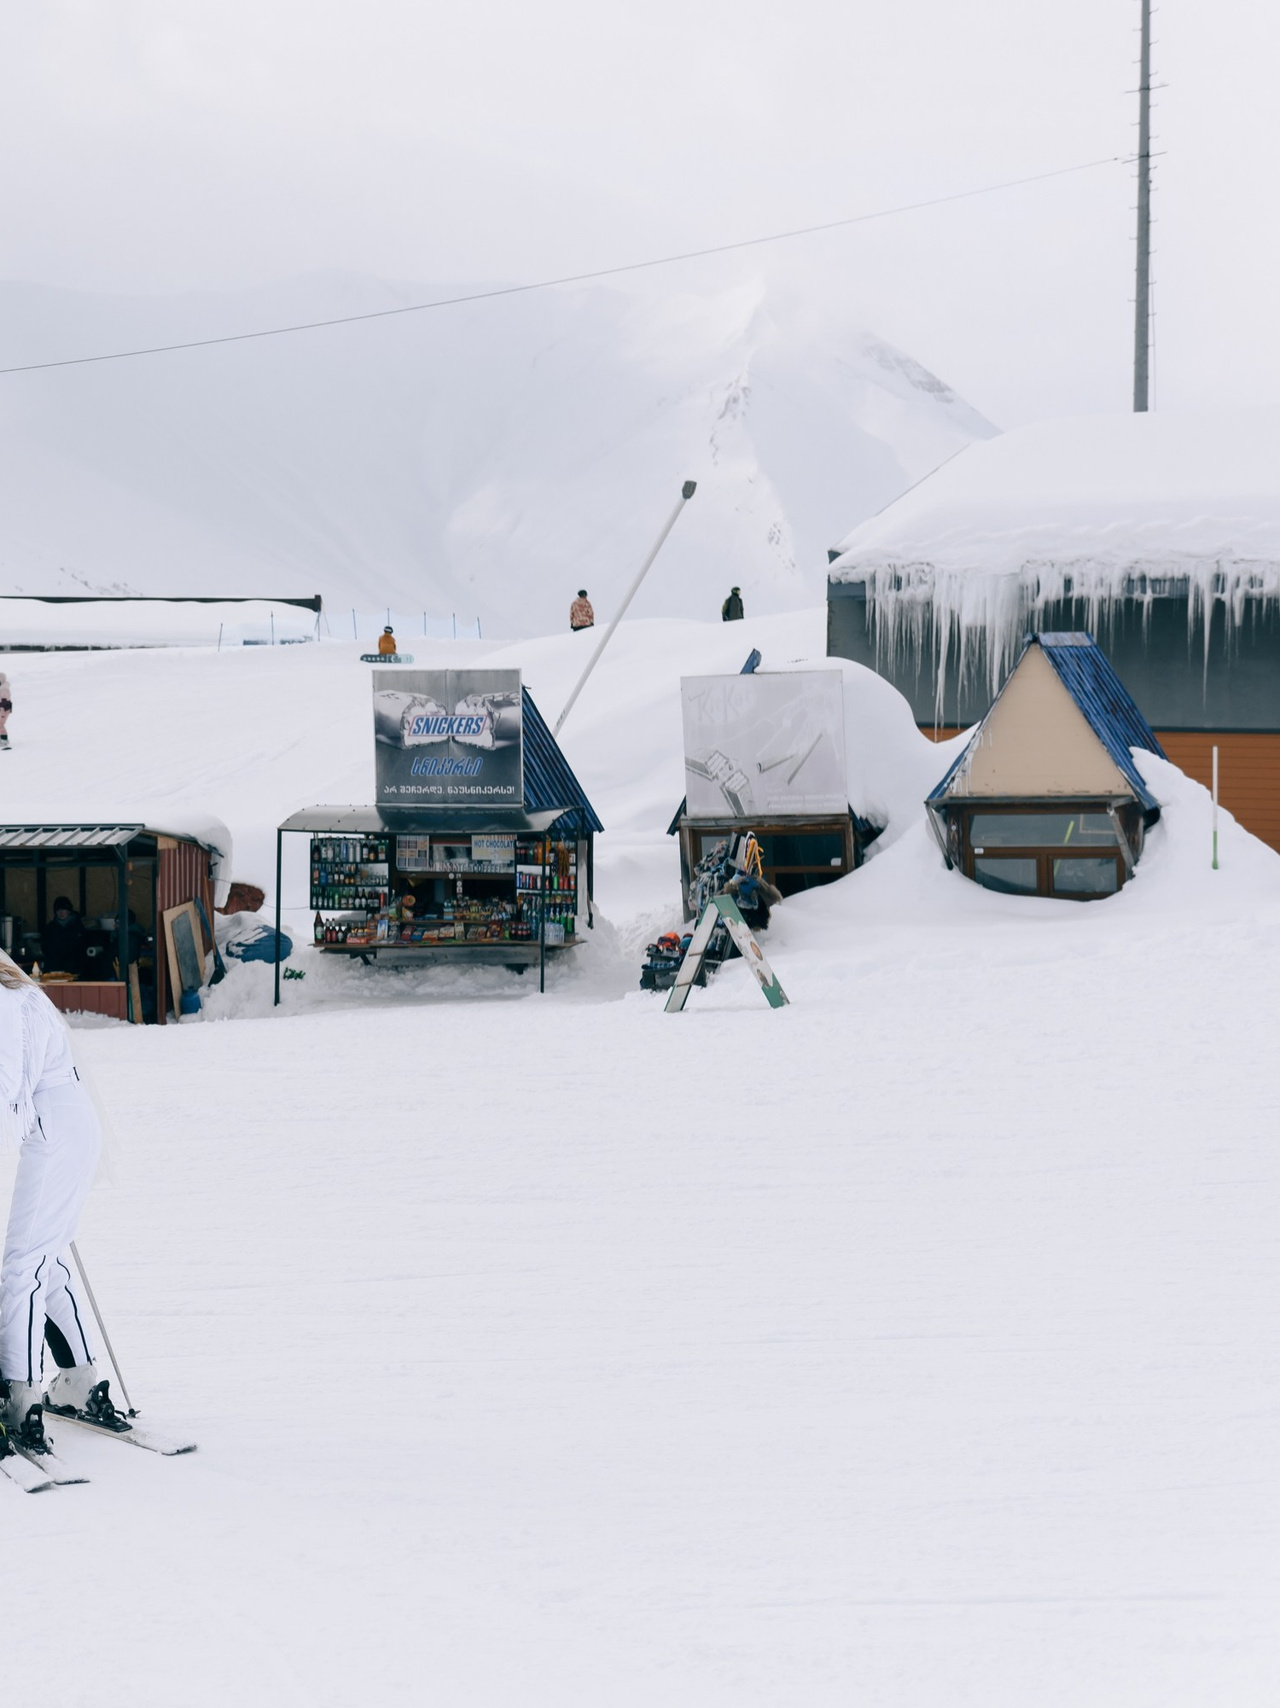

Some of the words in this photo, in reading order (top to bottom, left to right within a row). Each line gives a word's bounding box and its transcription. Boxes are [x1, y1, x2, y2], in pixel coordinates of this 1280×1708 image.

[412, 716, 484, 735] SNICKERS
[411, 757, 483, 776] სნიკერსი
[383, 785, 398, 794] არ
